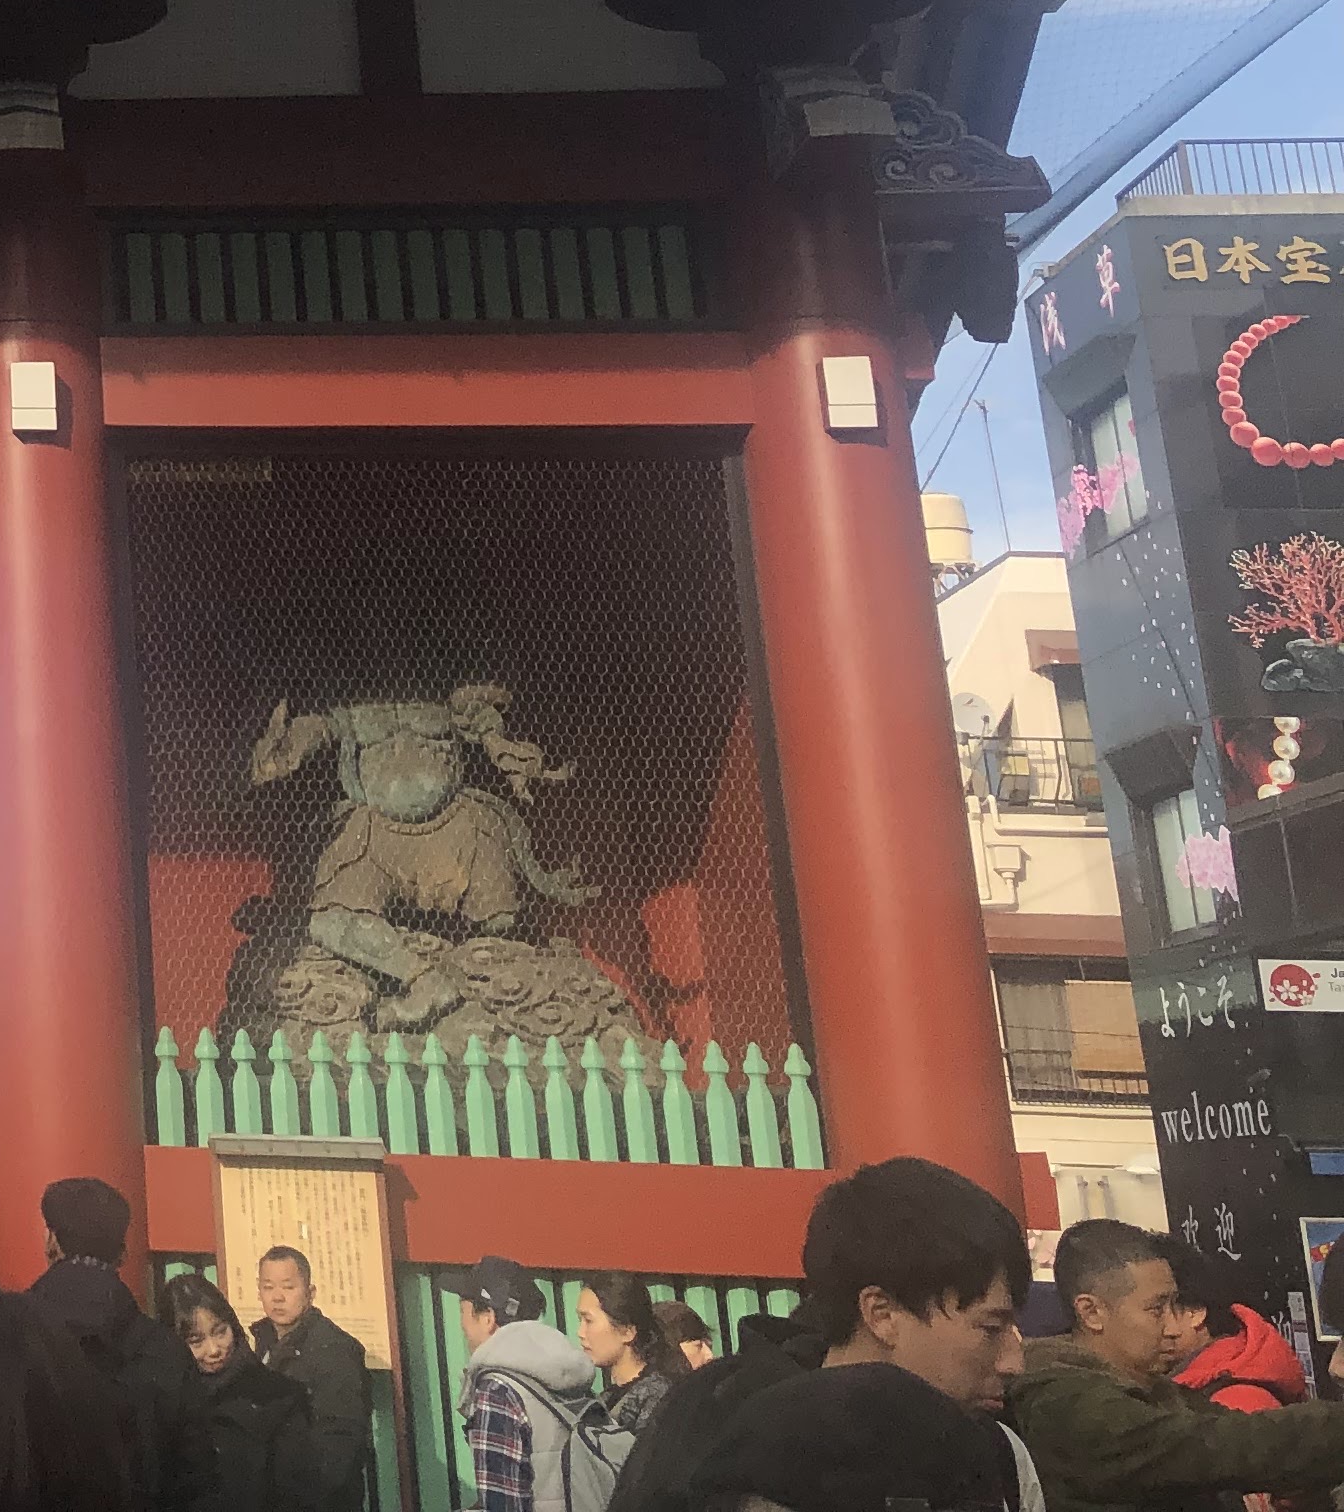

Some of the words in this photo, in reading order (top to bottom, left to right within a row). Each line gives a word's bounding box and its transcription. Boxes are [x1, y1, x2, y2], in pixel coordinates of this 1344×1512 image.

[1163, 236, 1344, 285] 日本宝
[1159, 974, 1236, 1038] ようこそ
[1160, 1091, 1272, 1144] welcome
